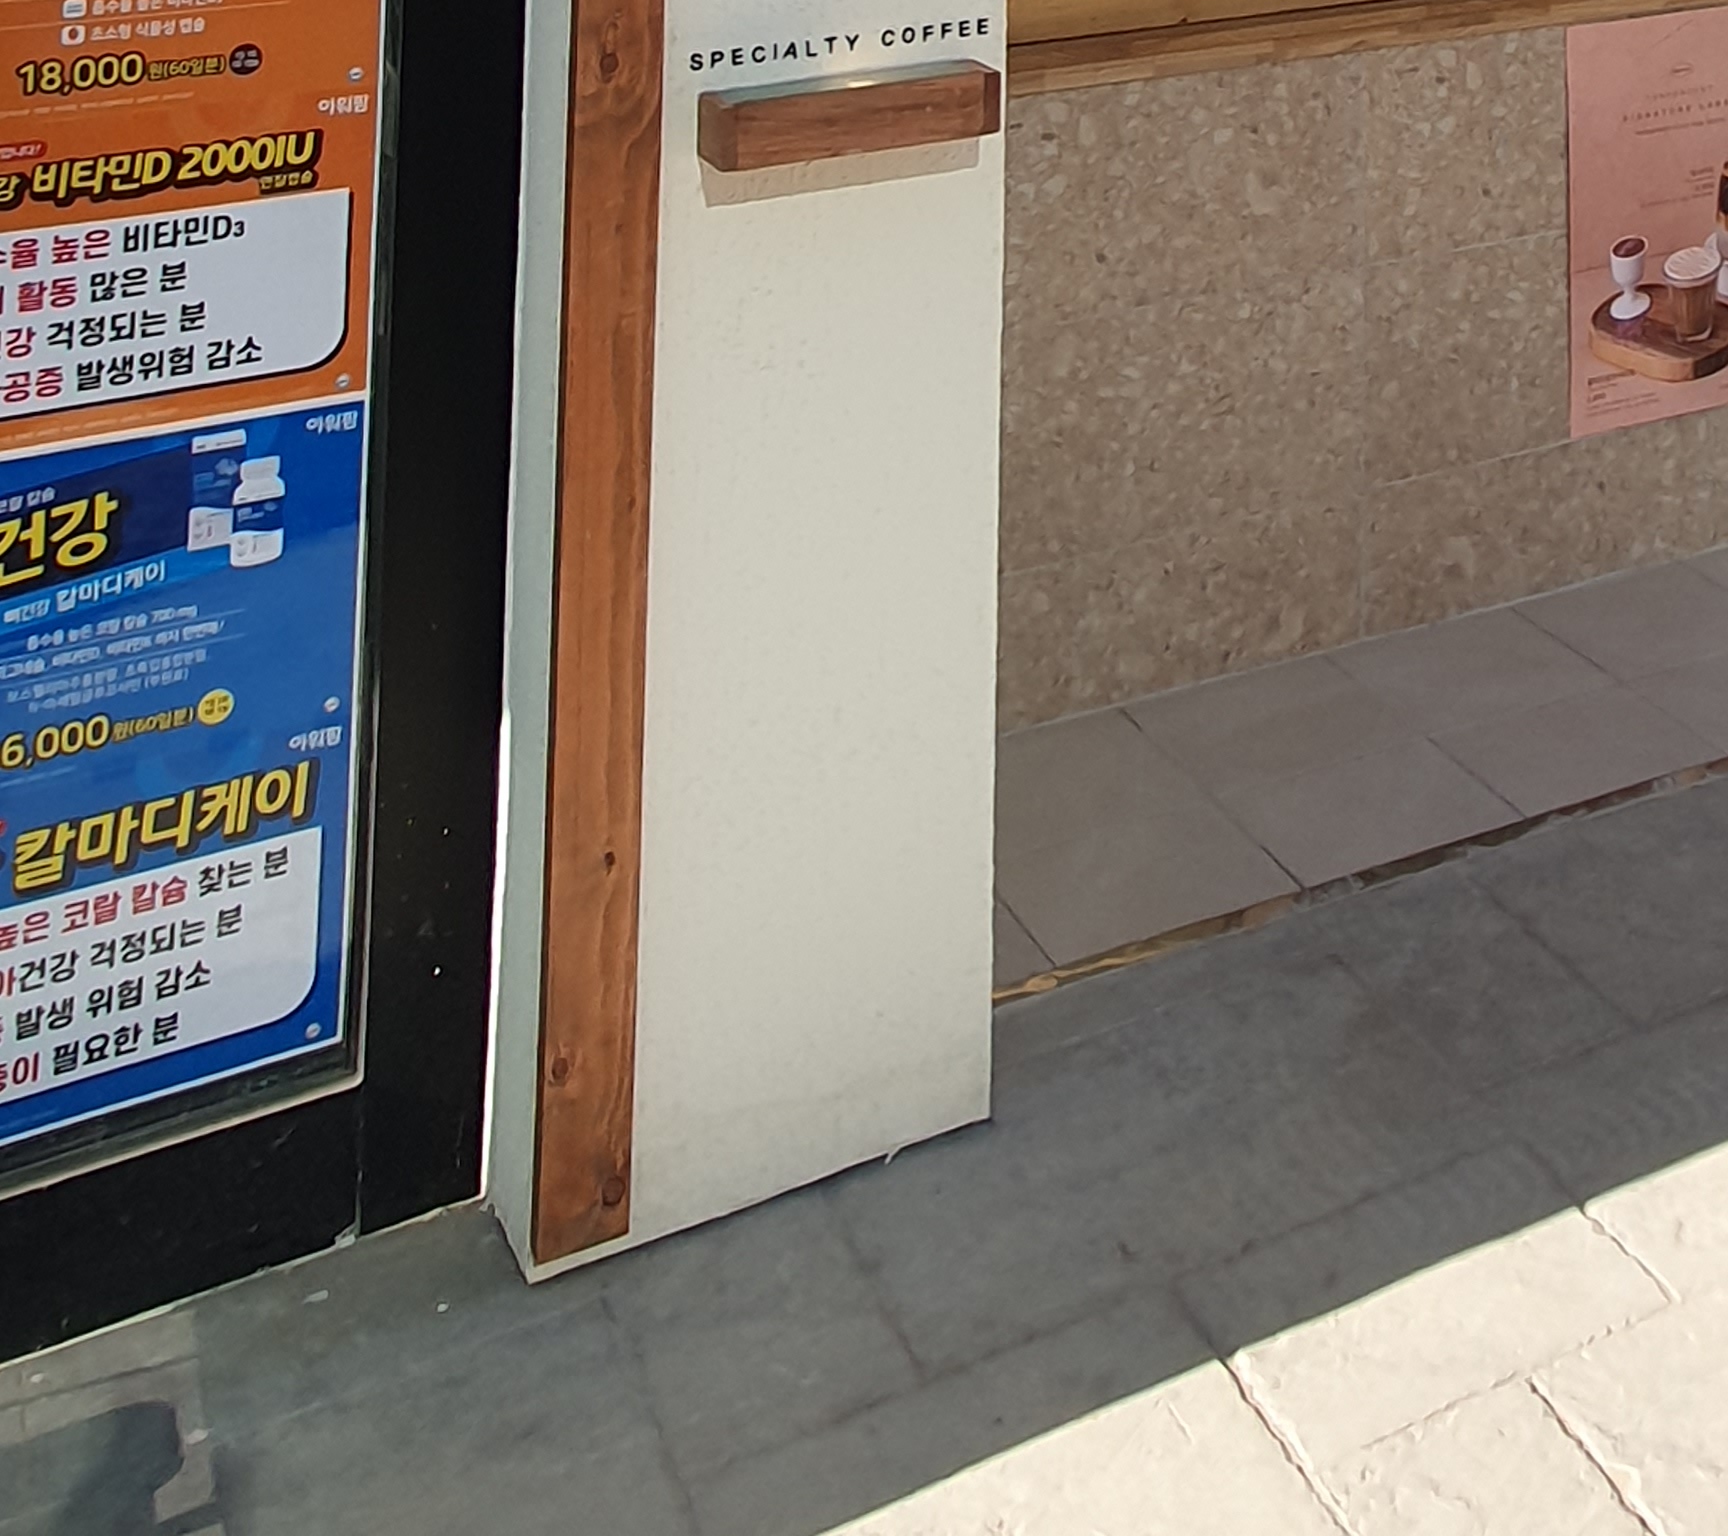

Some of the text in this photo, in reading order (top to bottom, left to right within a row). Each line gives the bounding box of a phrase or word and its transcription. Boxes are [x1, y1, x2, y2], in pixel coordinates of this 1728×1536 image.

[689, 17, 991, 72] SPECIALTY COFFEE
[18, 53, 145, 95] 18,000
[318, 94, 370, 116] 아워팜
[32, 151, 173, 199] 비타민D
[177, 131, 316, 182] 2000IU
[51, 228, 112, 265] 높은
[17, 260, 188, 314] 활동 많은 분
[46, 308, 168, 351] 걱정되는
[179, 300, 207, 332] 분
[76, 344, 195, 393] 발생위험
[206, 335, 264, 372] 감소
[13, 760, 310, 891] 칼마디케이
[60, 890, 123, 935] 코랄
[131, 874, 190, 912] 칼슘
[198, 859, 254, 898] 찾는
[263, 845, 290, 880] 분
[89, 917, 206, 970] 걱정되는
[216, 904, 244, 939] 분
[15, 958, 213, 1042] 발생 위험 감소
[52, 1024, 143, 1076] 필요한
[151, 1011, 180, 1046] 분
